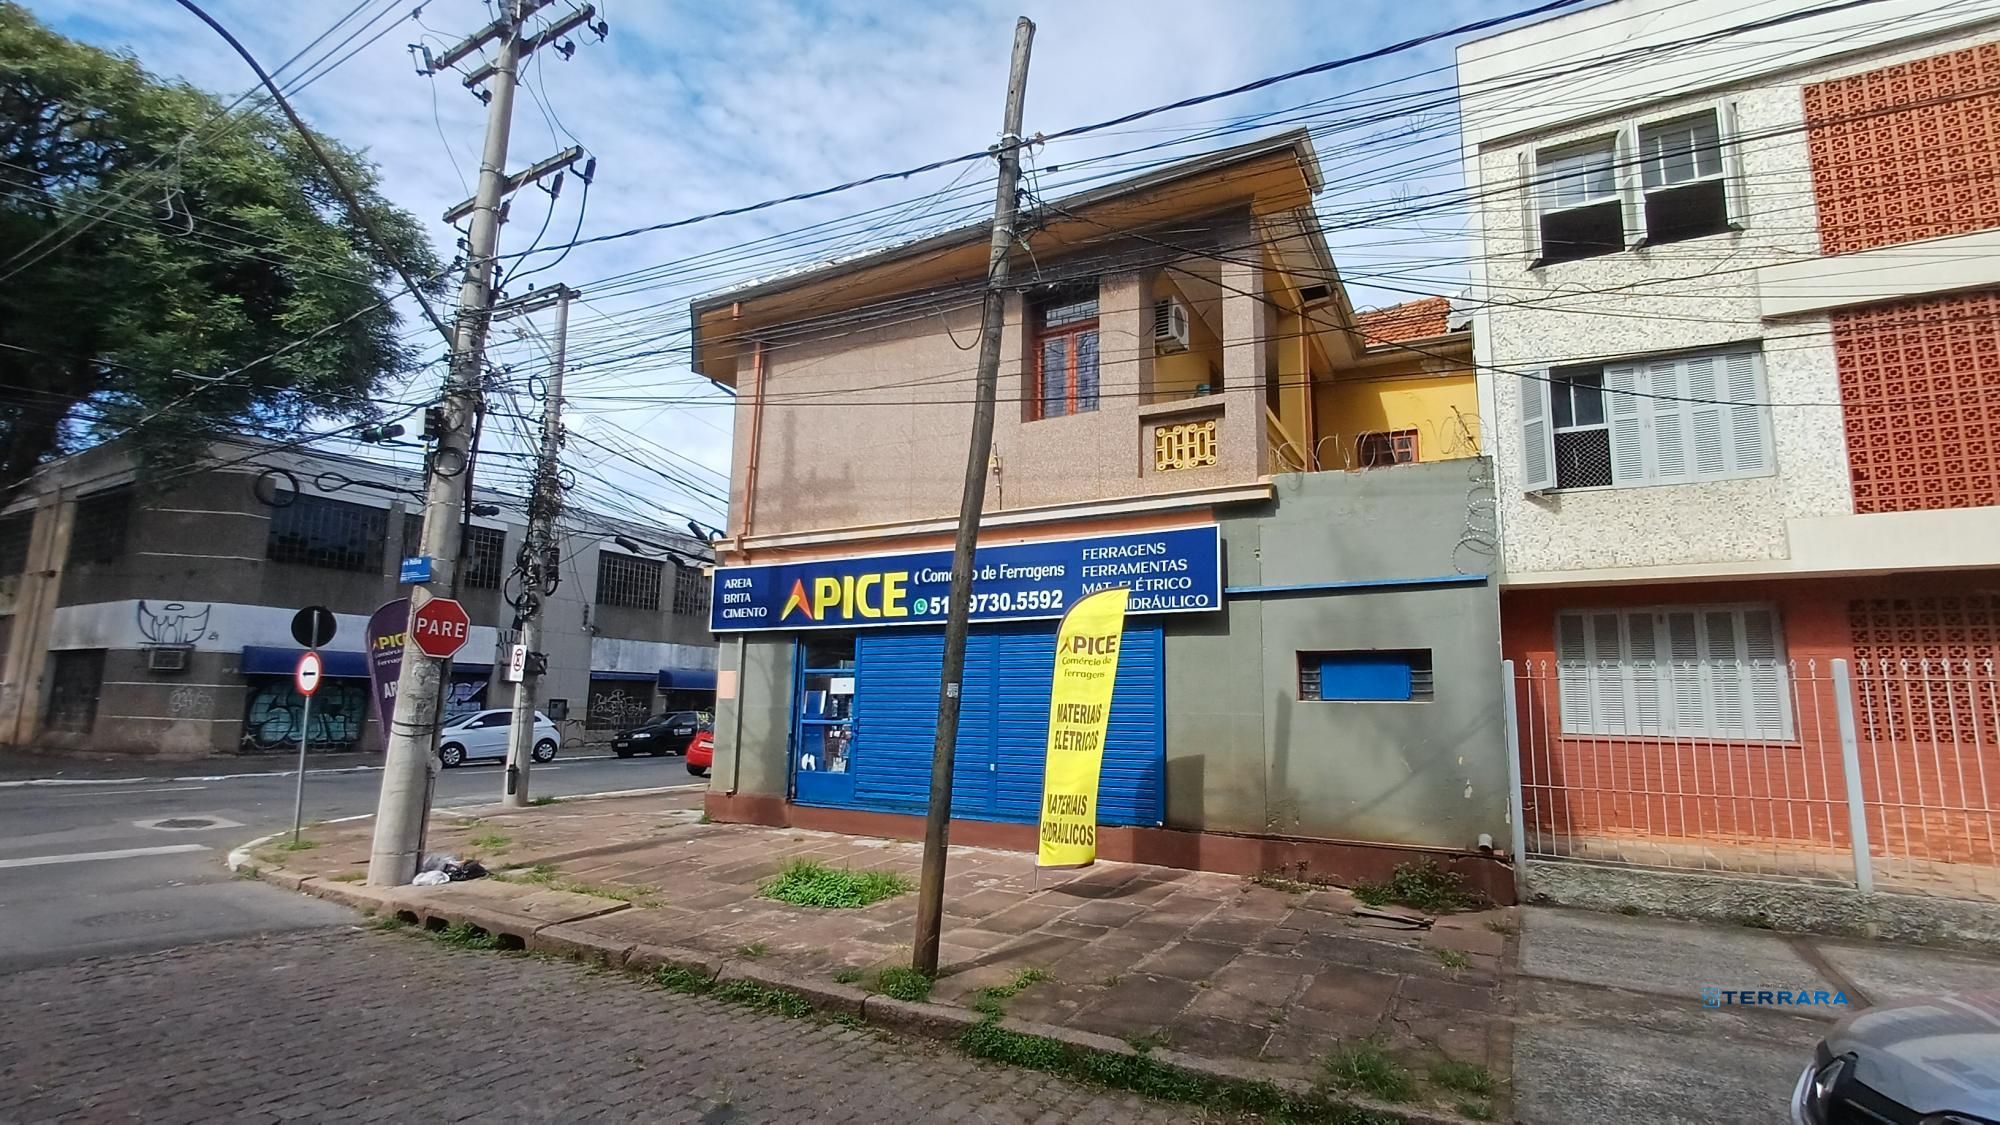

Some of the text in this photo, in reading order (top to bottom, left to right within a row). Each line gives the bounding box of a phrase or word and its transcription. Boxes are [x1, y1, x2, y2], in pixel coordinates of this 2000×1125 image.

[1082, 542, 1167, 561] FERRAGENS
[981, 565, 997, 580] de
[999, 563, 1065, 582] Ferragens
[1081, 558, 1188, 578] FERRAMENTAS
[724, 577, 753, 589] AREIA
[723, 593, 752, 604] BRITA
[1126, 594, 1209, 610] IDRÁULICO
[722, 606, 768, 619] CIMENTO
[416, 617, 466, 638] PARE
[372, 631, 406, 650] APIC
[1056, 703, 1103, 725] MATERIAIS
[1054, 725, 1099, 752] ELÉTRICOS
[1041, 818, 1094, 846] HIDRÁULICOS
